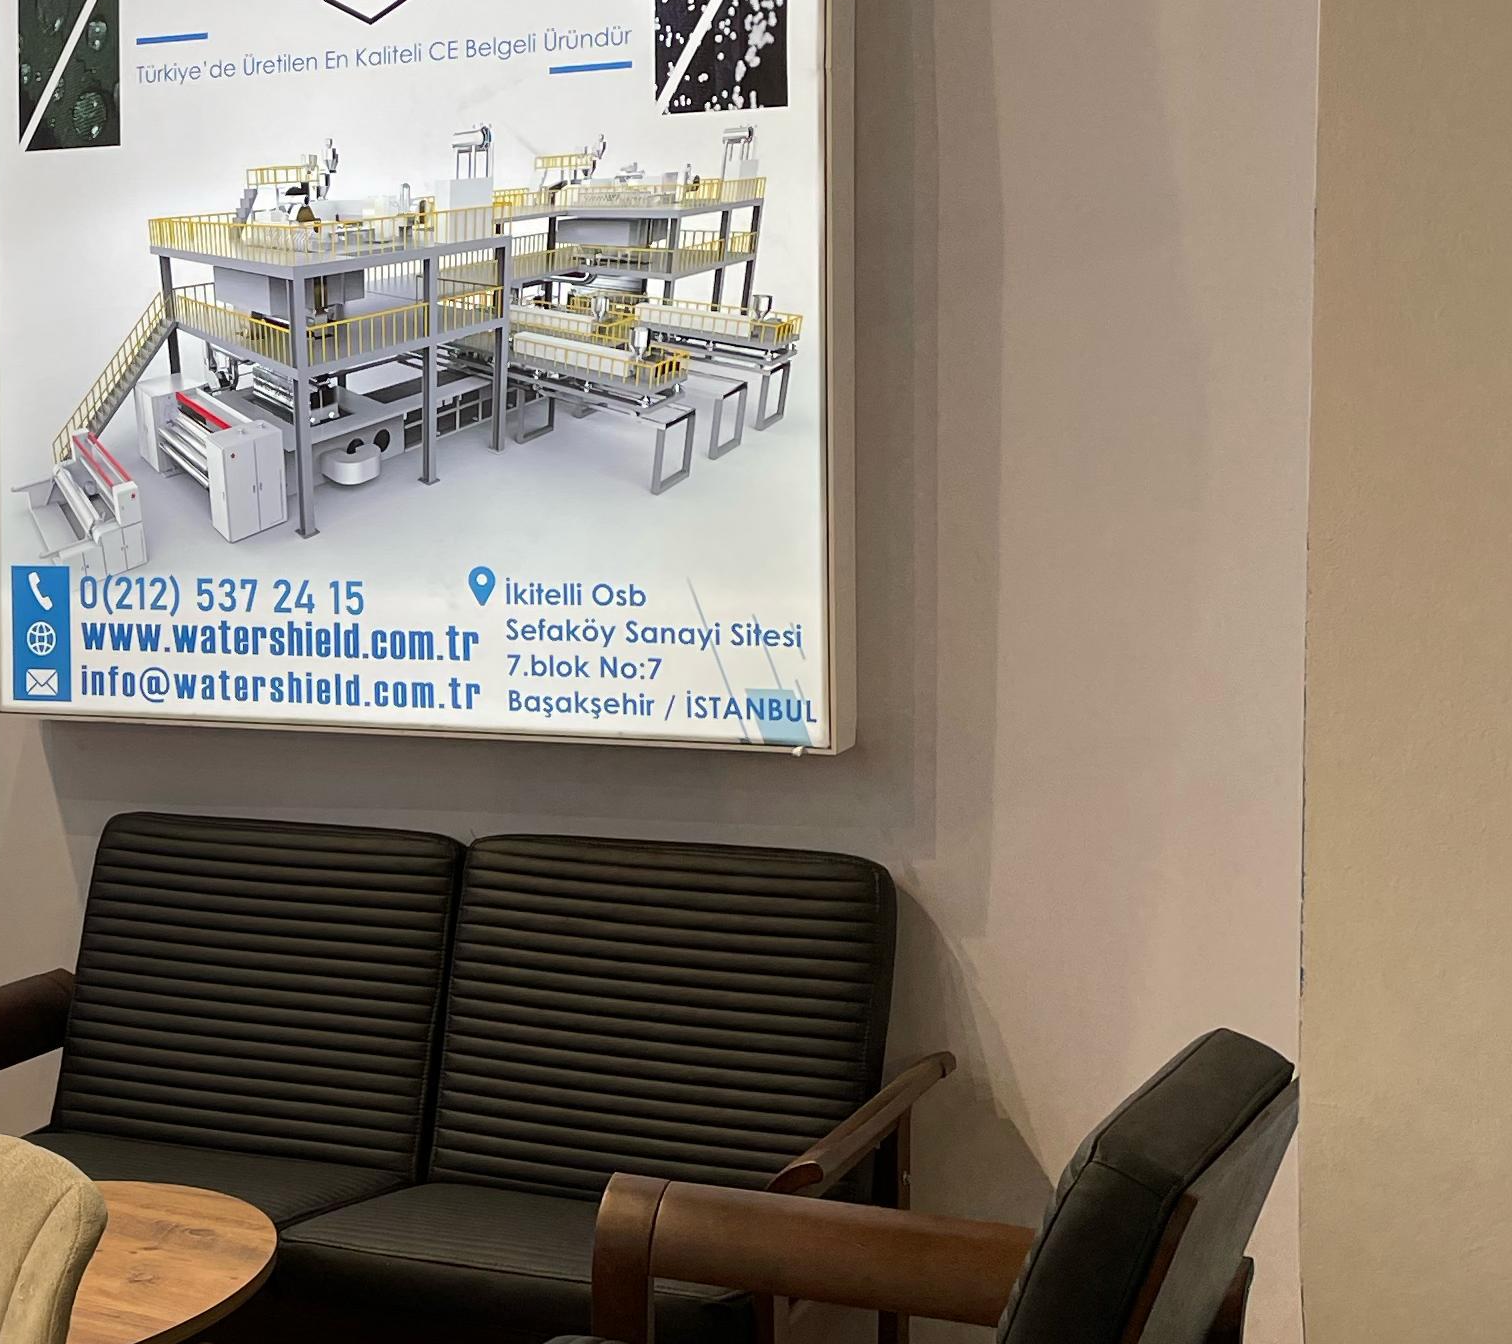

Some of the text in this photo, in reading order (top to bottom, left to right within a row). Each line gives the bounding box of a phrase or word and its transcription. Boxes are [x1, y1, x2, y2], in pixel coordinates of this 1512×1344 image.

[136, 26, 632, 85] Türkiye'de Üretilen En Kaliteli CE Belgeli Üründür
[80, 574, 364, 617] 0(212) 537 24 15
[505, 578, 647, 607] İkitelli Osb
[81, 620, 479, 661] www.watershield.com.tr
[506, 618, 802, 650] Sefaköy Sanayi Sitesi
[507, 654, 662, 680] 7.blok No:7
[81, 664, 480, 710] info@watershield.com.tr
[508, 689, 817, 723] Başakşehir / İSTANBUL
